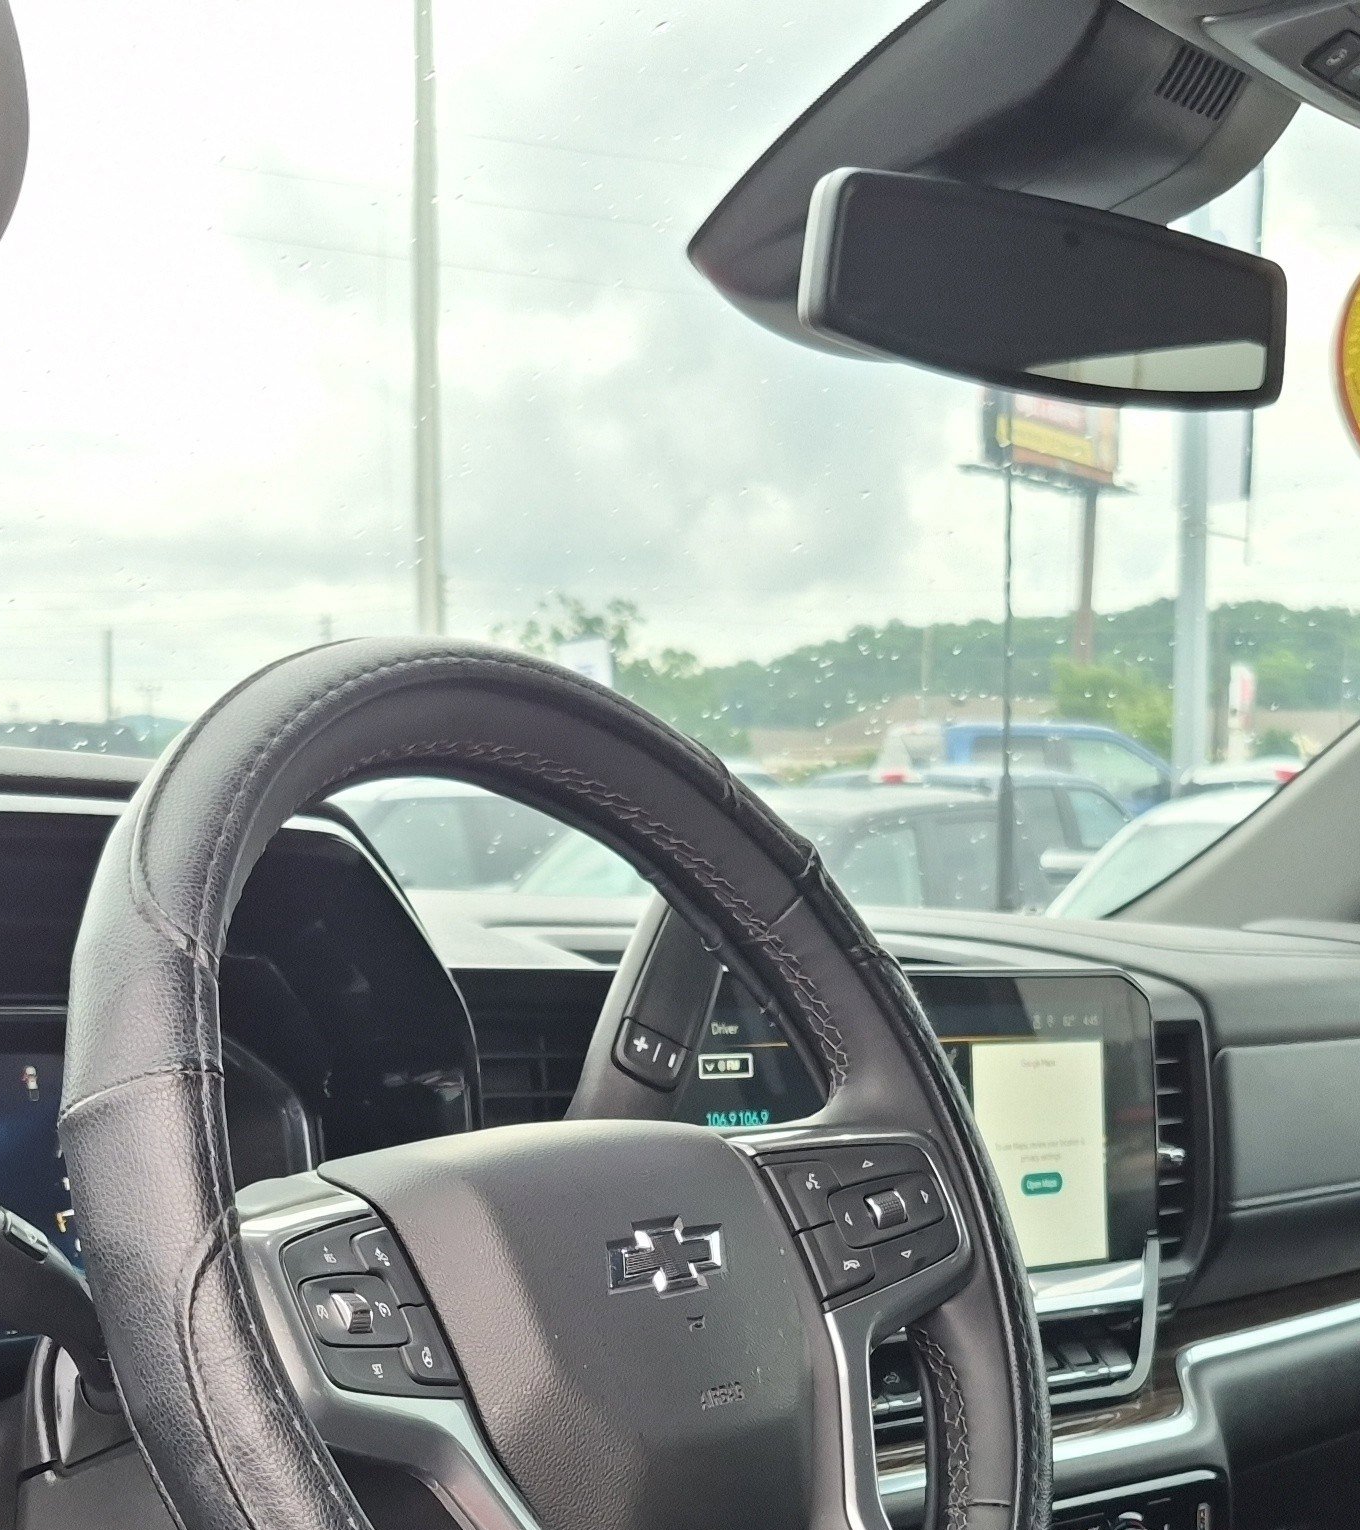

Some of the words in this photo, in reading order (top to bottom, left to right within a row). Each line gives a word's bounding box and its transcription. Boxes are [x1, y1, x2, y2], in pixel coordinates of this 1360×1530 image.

[711, 1022, 739, 1036] Driver
[706, 1111, 736, 1127] 106.9
[739, 1109, 770, 1126] 106.9
[323, 1253, 337, 1264] RES
[371, 1363, 383, 1375] SET
